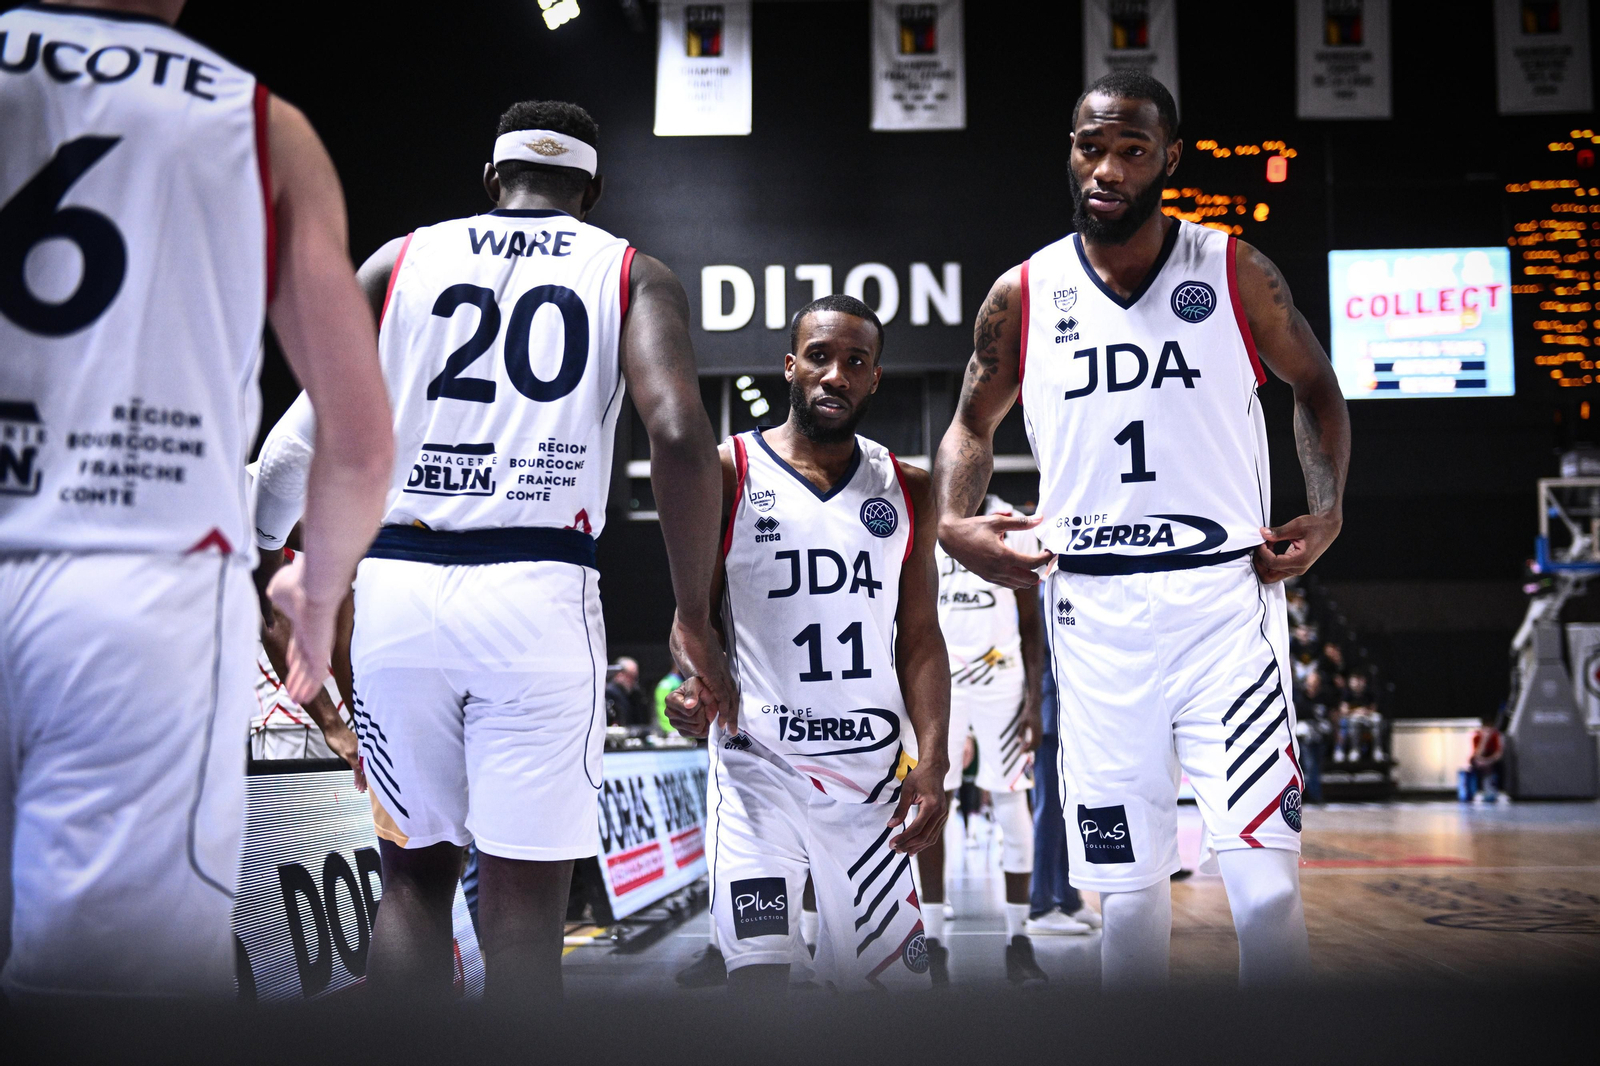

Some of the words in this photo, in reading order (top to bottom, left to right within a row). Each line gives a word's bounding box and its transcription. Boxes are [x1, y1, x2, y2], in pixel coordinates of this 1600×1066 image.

[0, 134, 128, 338] 6
[468, 227, 577, 259] WARE
[701, 262, 962, 331] DIJON
[1346, 284, 1503, 319] COLLECT
[426, 283, 590, 404] 20
[1055, 332, 1080, 344] errea
[1064, 340, 1202, 400] JDA
[421, 453, 498, 467] OMAGERE
[509, 458, 585, 471] BOURGOGNE
[1113, 419, 1156, 483] 1
[406, 463, 492, 491] DELIN
[518, 474, 577, 487] FRANCHE
[755, 532, 781, 543] errea
[767, 548, 883, 599] JDA
[792, 621, 872, 682] 11
[735, 890, 785, 918] Plus
[740, 915, 785, 924] COLLECTION
